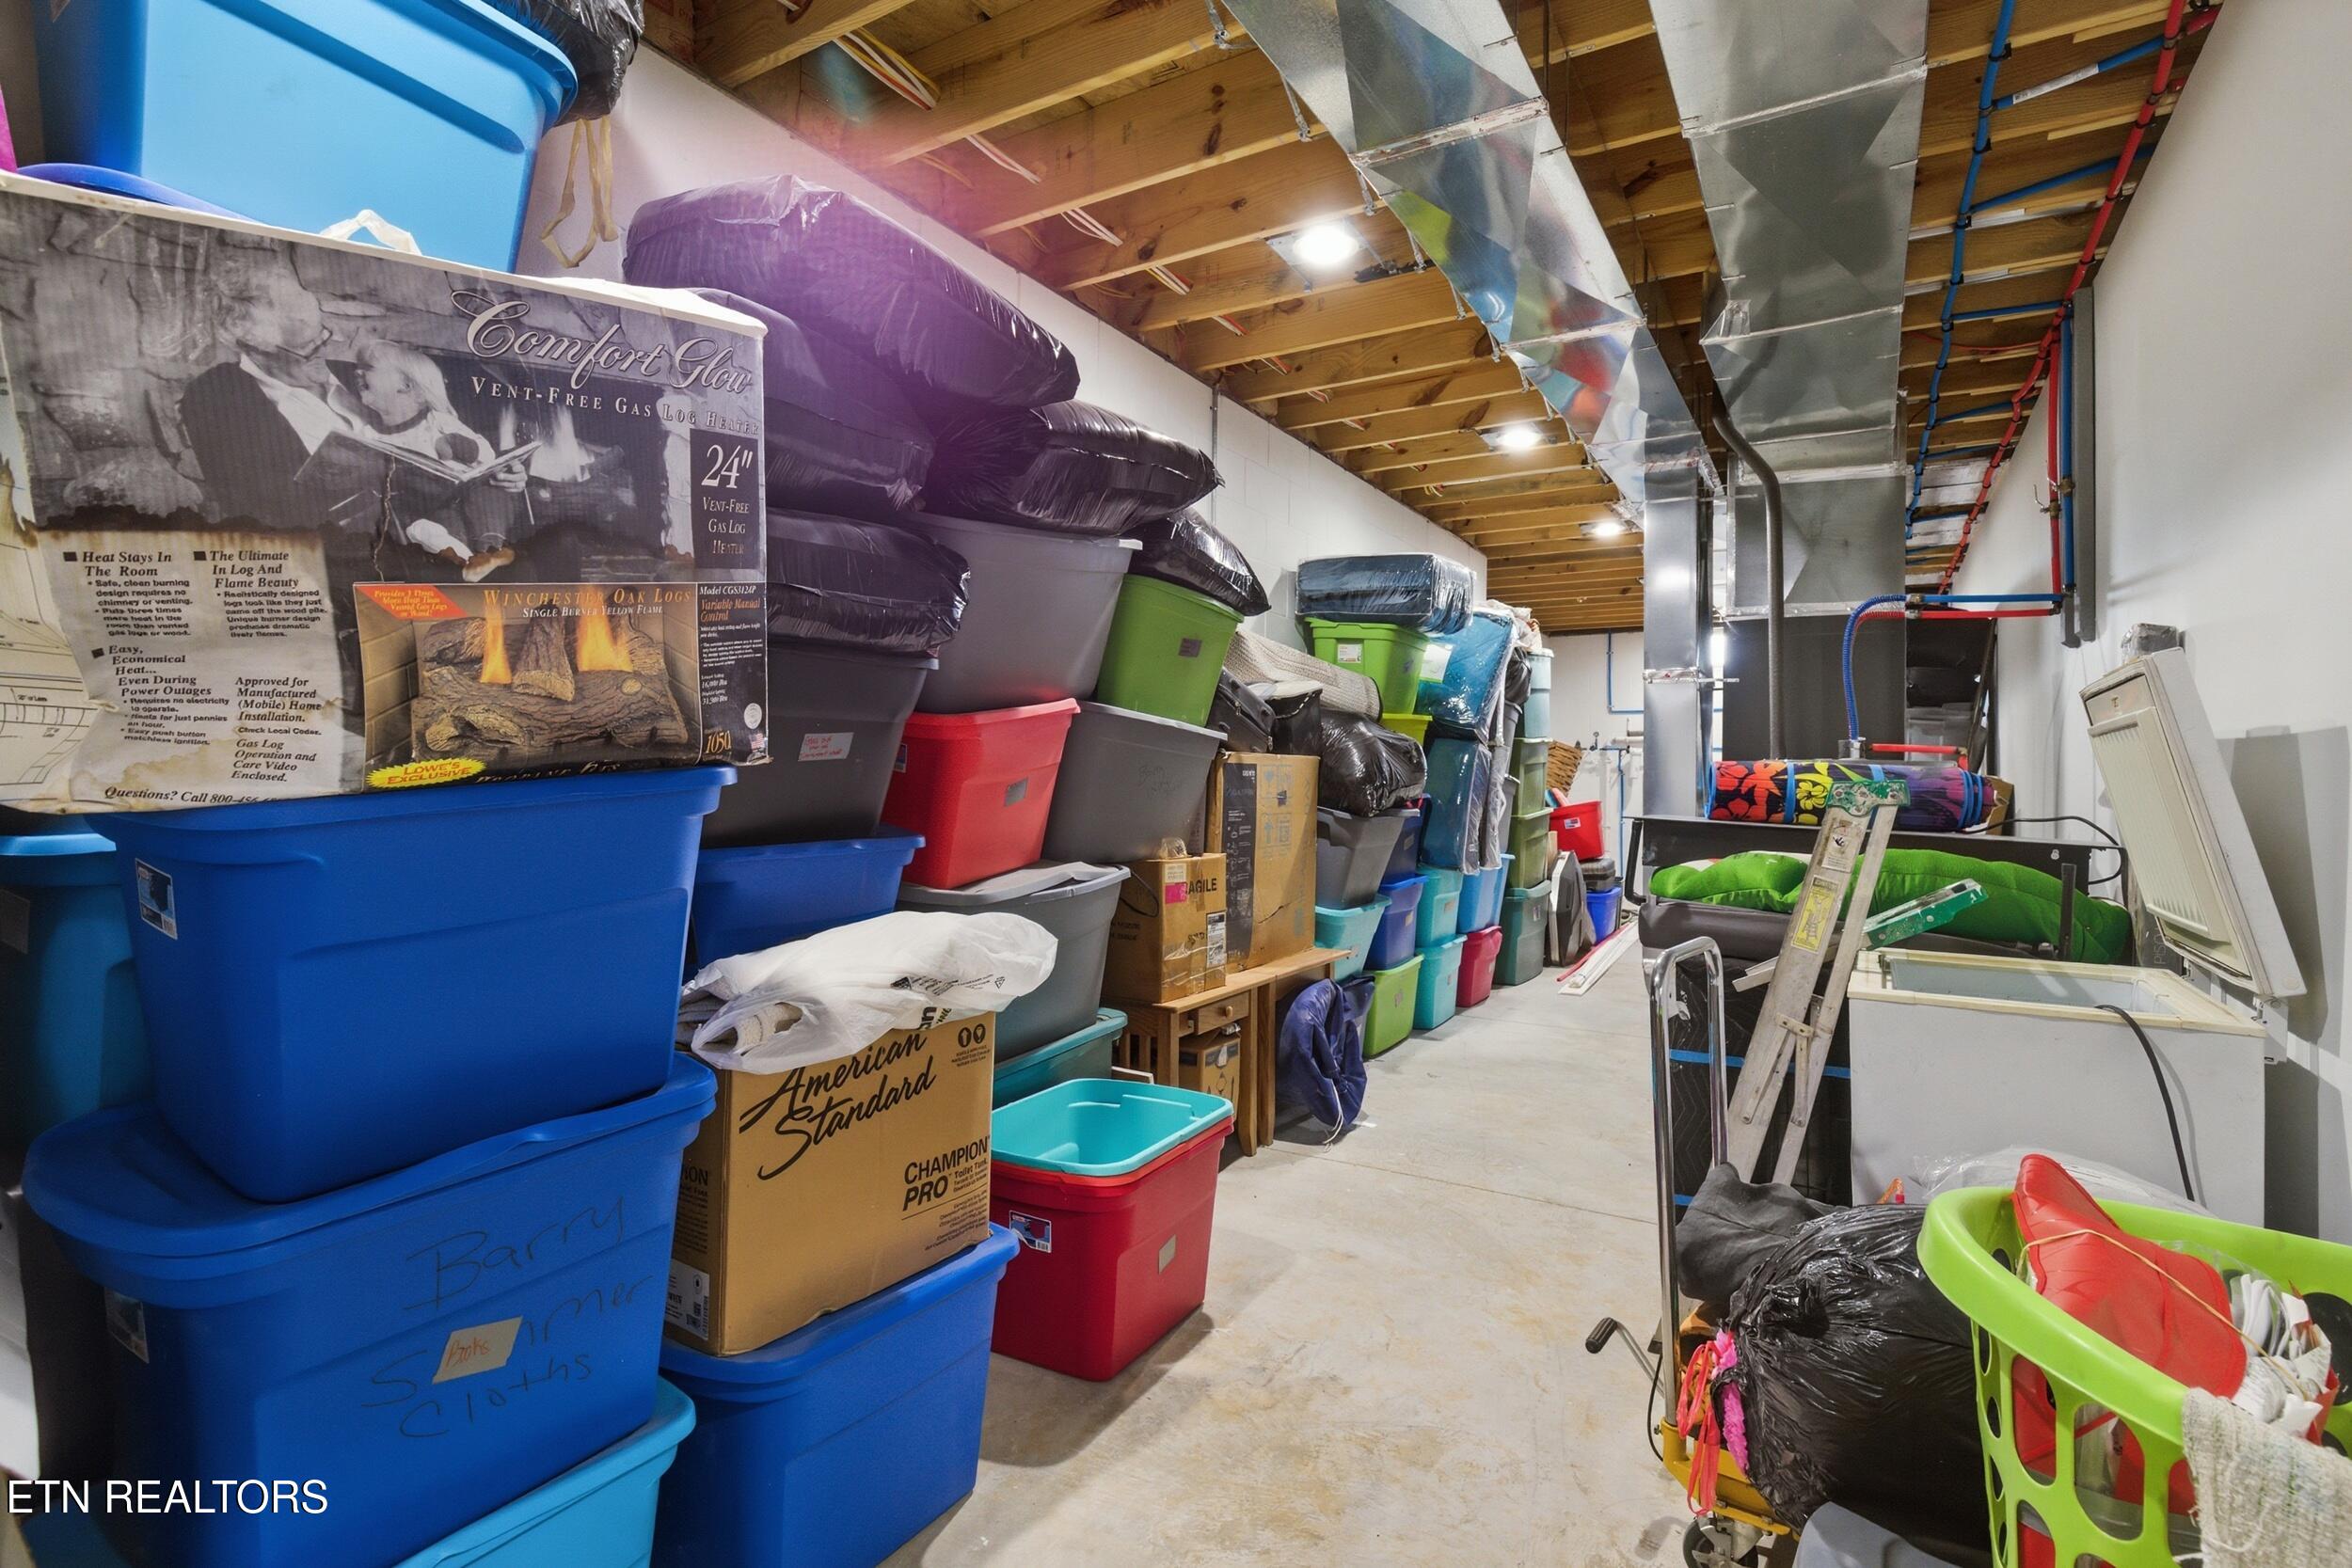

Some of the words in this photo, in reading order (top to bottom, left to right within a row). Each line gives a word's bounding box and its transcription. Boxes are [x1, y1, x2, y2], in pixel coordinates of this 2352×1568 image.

[452, 291, 664, 389] Comfort
[669, 337, 754, 394] Glow
[471, 376, 602, 410] VENT-FREE
[615, 397, 651, 418] GAS
[663, 404, 696, 423] LOG
[707, 412, 758, 435] HEATER
[701, 444, 753, 489] 24"
[704, 497, 750, 514] VENT-FREE
[707, 519, 726, 532] GAS
[729, 519, 746, 534] LOG
[713, 540, 744, 555] HEATER
[82, 551, 115, 562] Heat
[119, 551, 153, 564] Stays
[157, 551, 172, 562] In
[209, 550, 234, 561] The
[238, 550, 289, 561] Ultimate
[85, 565, 111, 577] The
[119, 565, 158, 577] Room
[213, 564, 226, 575] In
[230, 564, 254, 577] Log
[257, 564, 282, 575] And
[95, 579, 121, 588] Safe,
[152, 579, 190, 588] burning
[215, 578, 254, 588] Flame
[258, 578, 299, 589] Beauty
[95, 589, 129, 597] design
[132, 589, 171, 597] requires
[700, 586, 722, 595] Model
[98, 598, 139, 607] chimney
[484, 589, 605, 607] WINCHESTER
[613, 588, 645, 604] OAK
[654, 588, 691, 603] LOGS
[701, 598, 732, 610] Variable
[734, 597, 761, 610] Manual
[523, 605, 558, 618] SINGLE
[601, 605, 633, 616] YELLOW
[636, 604, 663, 614] FLAME
[701, 610, 729, 622] Control
[108, 645, 144, 655] Easy,
[112, 655, 186, 665] Economical
[115, 666, 156, 675] Heat...
[119, 676, 150, 687] Even
[153, 675, 197, 687] During
[235, 677, 289, 688] Approved
[290, 677, 310, 688] for
[121, 688, 160, 697] Power
[163, 686, 212, 696] Outages
[236, 688, 316, 699] Manufactured
[237, 699, 286, 710] (Mobile)
[289, 700, 322, 710] Home
[237, 711, 306, 722] Installation.
[236, 738, 259, 748] Gas
[262, 739, 284, 750] Log
[234, 750, 292, 760] Operation
[294, 752, 316, 762] and
[233, 760, 262, 769] Care
[265, 761, 297, 771] Video
[404, 761, 460, 775] LOWE'S
[231, 770, 287, 782] Enclosed.
[387, 767, 472, 784] EXCLUSIVE
[104, 785, 178, 800] Questions?
[181, 791, 208, 803] Call
[739, 1033, 928, 1134] American
[757, 1054, 937, 1180] Standard
[904, 1135, 988, 1185] CHAMPION
[903, 1175, 948, 1212] PRO
[403, 1196, 625, 1310] Barry
